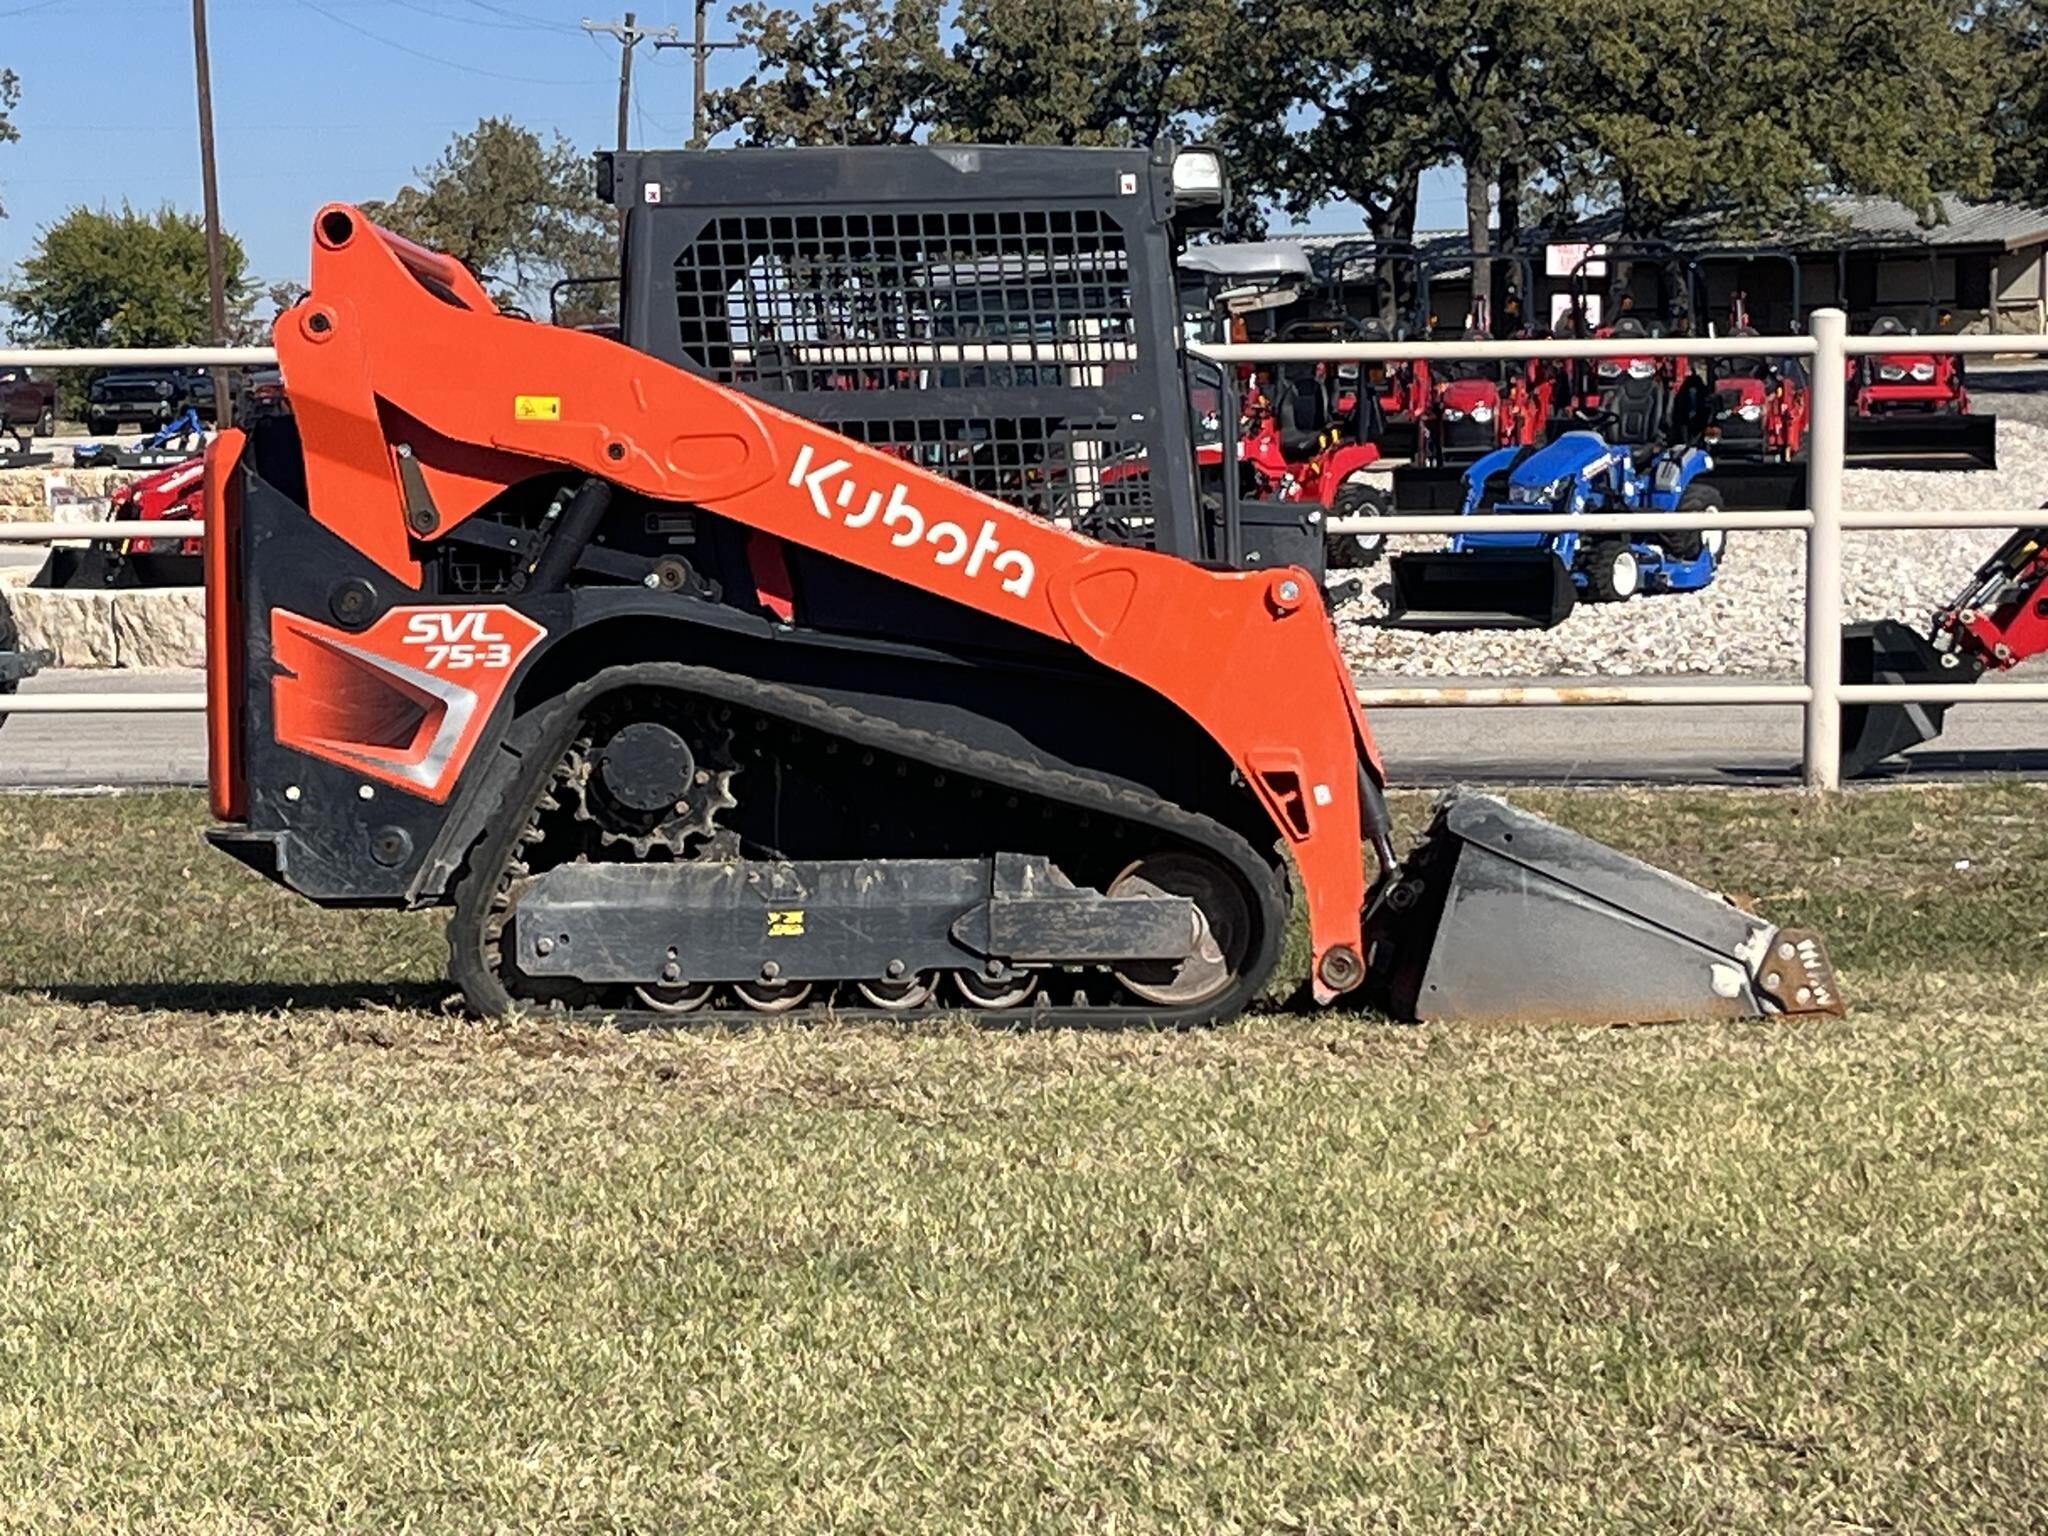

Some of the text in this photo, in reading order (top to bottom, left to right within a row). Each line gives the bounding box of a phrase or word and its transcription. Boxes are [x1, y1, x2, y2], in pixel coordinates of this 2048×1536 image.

[788, 444, 1035, 599] Kubota
[402, 612, 505, 644] SVL
[424, 643, 512, 670] 75-3
